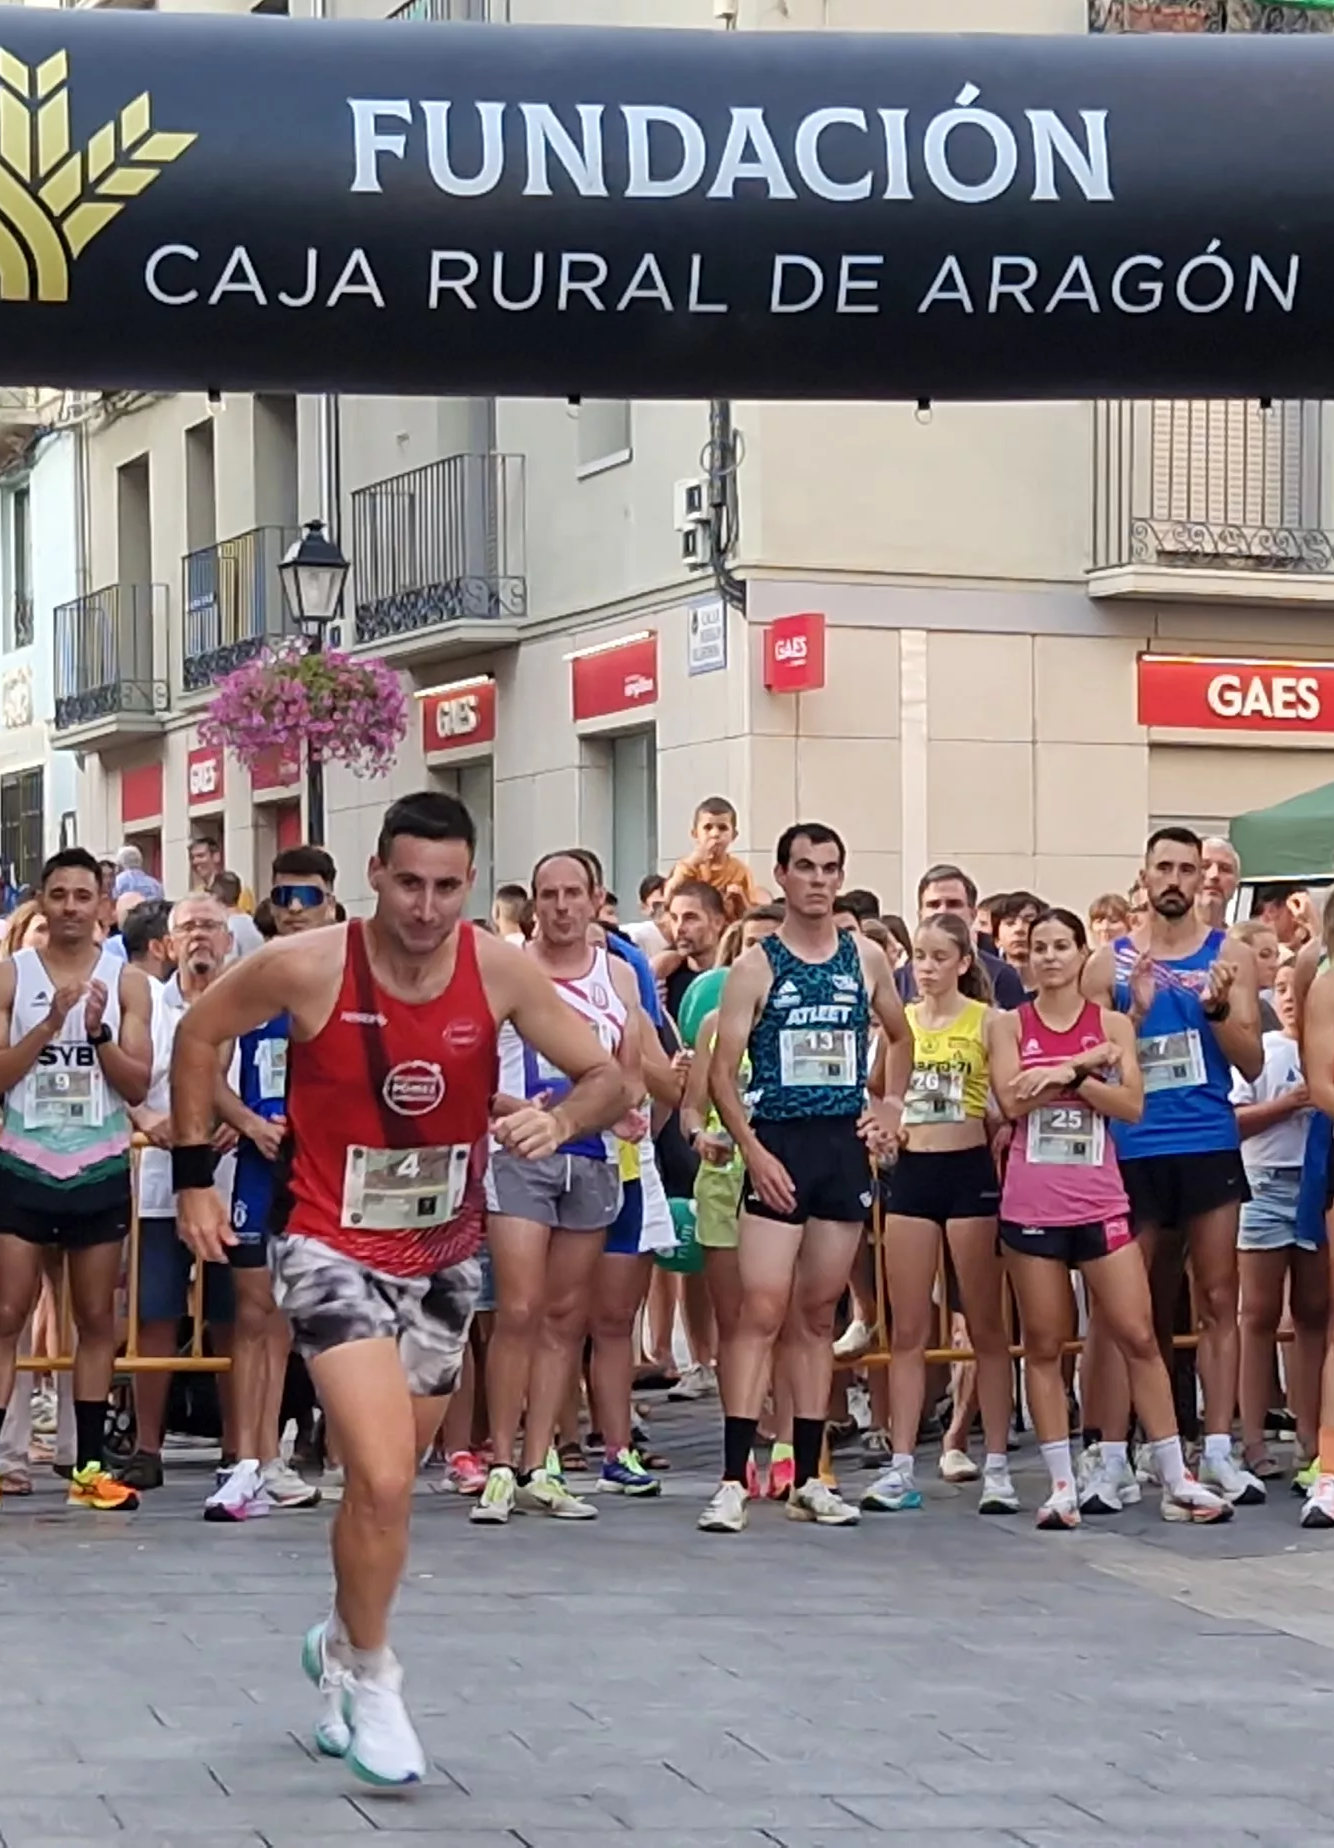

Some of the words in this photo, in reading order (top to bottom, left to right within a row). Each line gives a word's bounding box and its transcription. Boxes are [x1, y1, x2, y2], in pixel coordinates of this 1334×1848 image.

[347, 82, 1114, 204] FUNDACIÓN
[145, 243, 385, 308] CAJA
[428, 250, 728, 313] RURAL
[770, 254, 884, 314] DE
[918, 238, 1301, 315] ARAGÓN
[1207, 673, 1321, 720] GAES
[806, 1031, 834, 1050] 13
[55, 1073, 70, 1091] 9
[1050, 1110, 1083, 1129] 25
[396, 1152, 421, 1179] 4
